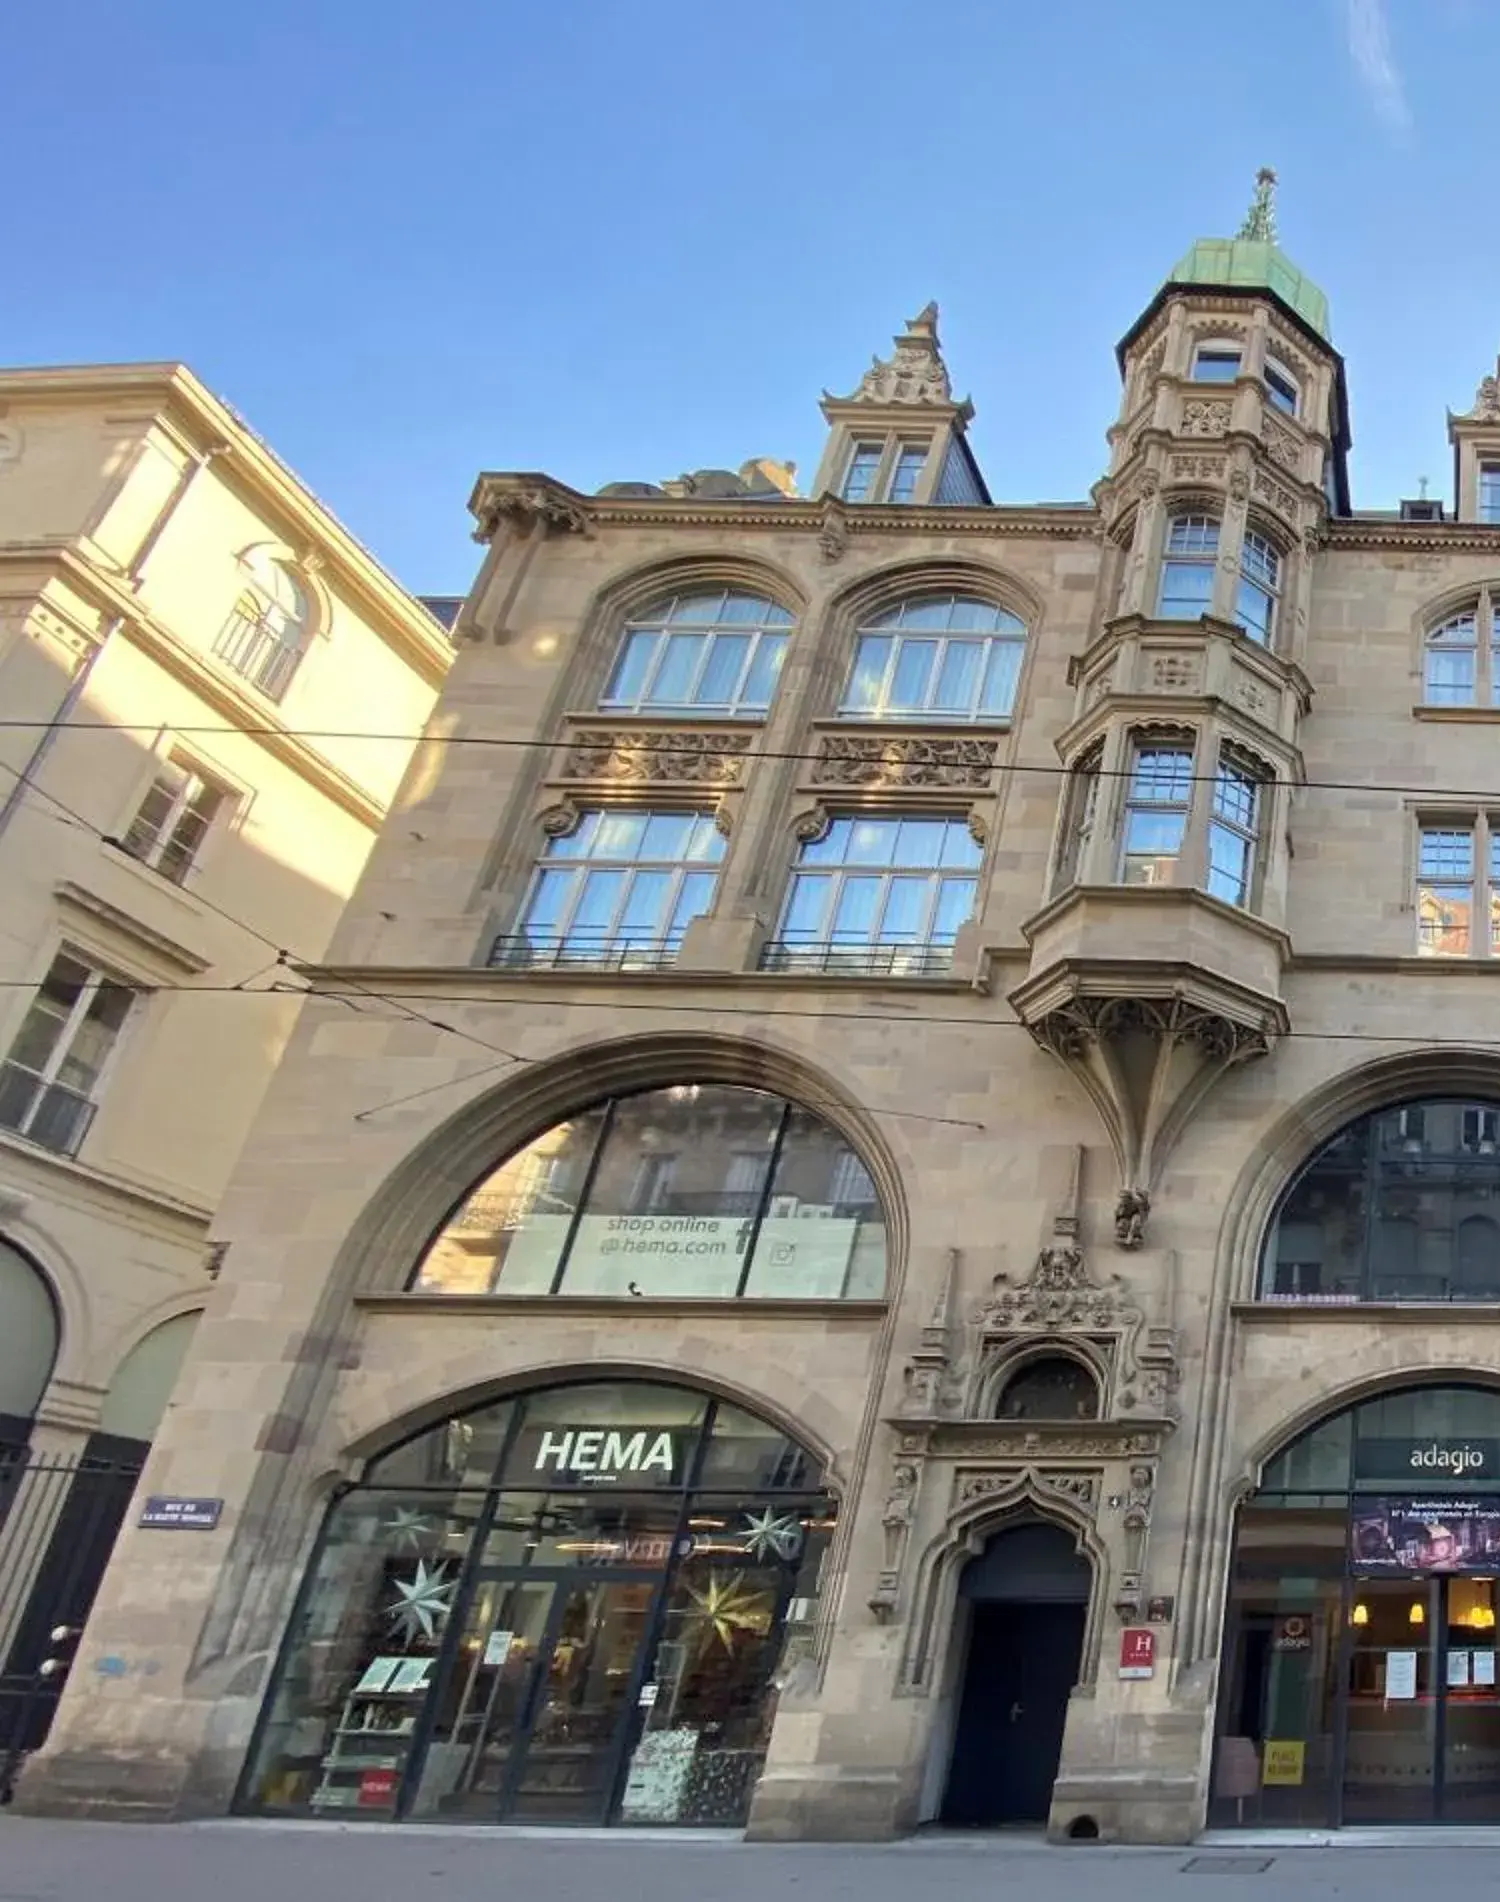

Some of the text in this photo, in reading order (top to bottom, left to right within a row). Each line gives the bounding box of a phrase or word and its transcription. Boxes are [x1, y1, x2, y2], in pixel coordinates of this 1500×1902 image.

[607, 1216, 720, 1237] shop online
[534, 1431, 674, 1471] HEMA
[1409, 1443, 1485, 1475] adagio
[1136, 1635, 1152, 1651] H
